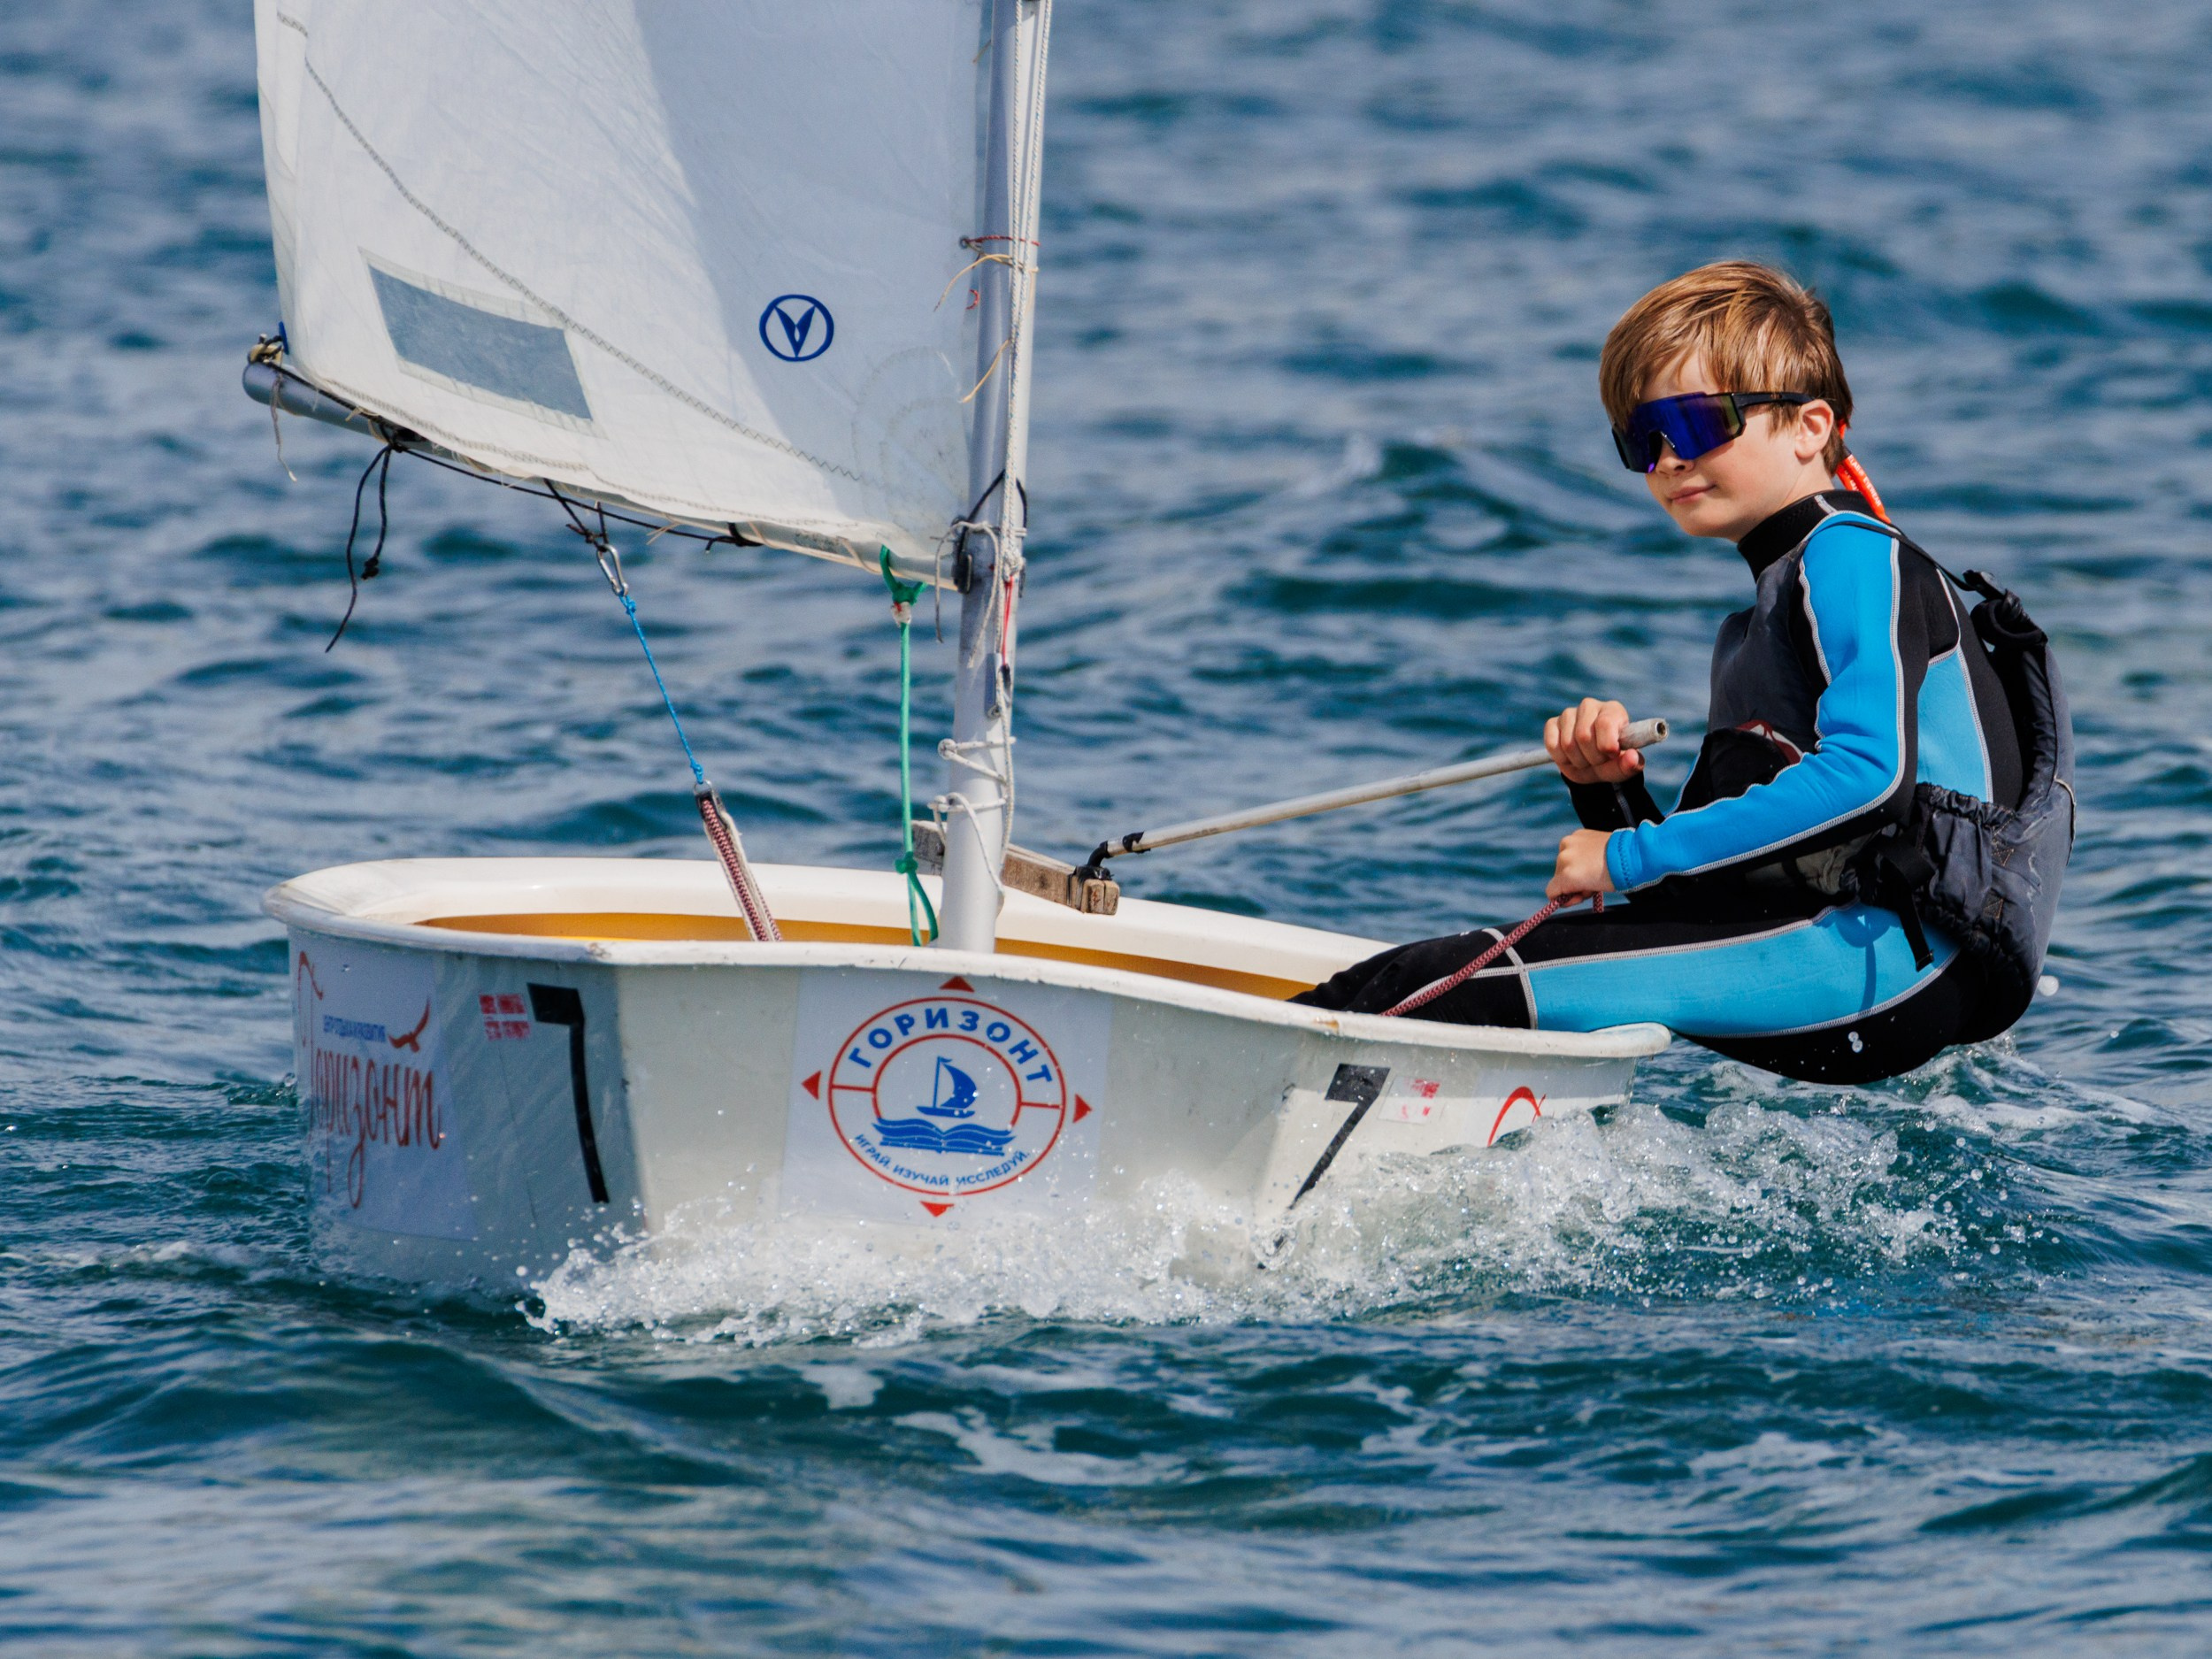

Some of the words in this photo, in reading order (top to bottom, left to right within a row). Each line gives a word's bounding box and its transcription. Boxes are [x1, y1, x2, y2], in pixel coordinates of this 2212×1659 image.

[526, 982, 611, 1204] 7
[848, 1007, 1053, 1083] ГОРИЗОНТ
[1288, 1063, 1392, 1210] 7
